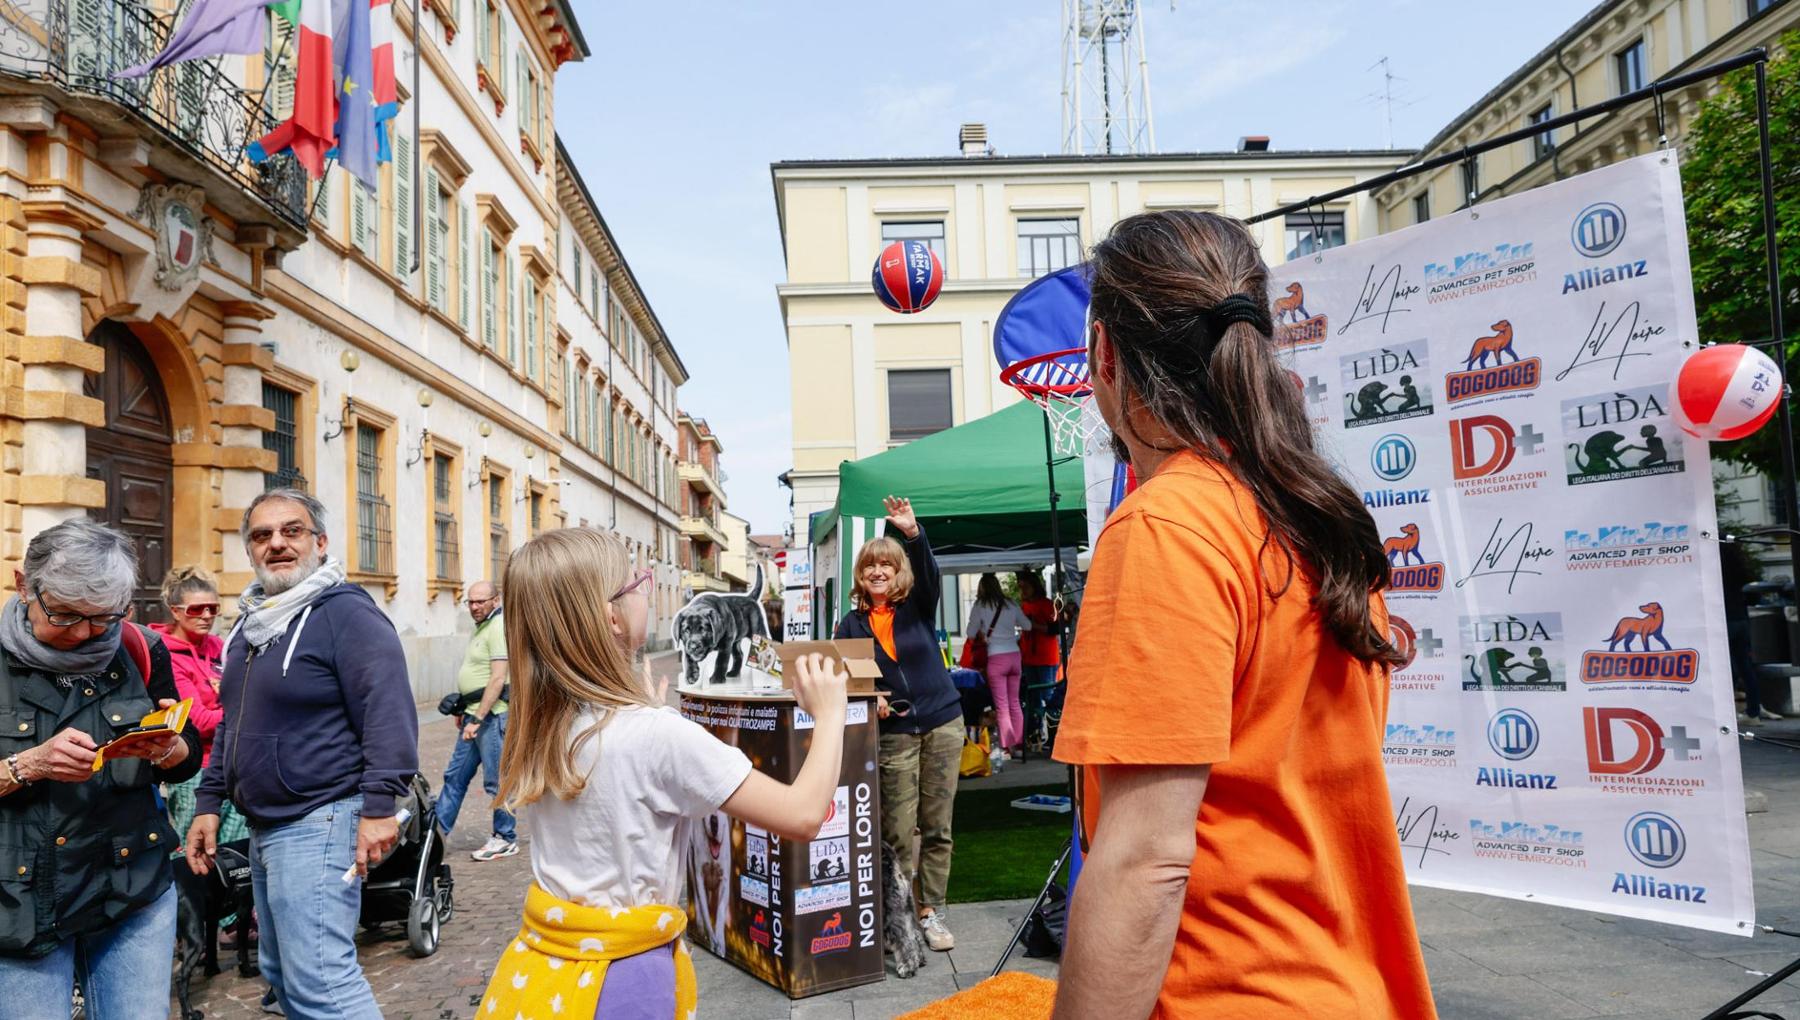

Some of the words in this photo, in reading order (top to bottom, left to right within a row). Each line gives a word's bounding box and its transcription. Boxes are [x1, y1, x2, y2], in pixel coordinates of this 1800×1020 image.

[1430, 276, 1480, 294] ADVANCED
[1484, 270, 1503, 281] PET
[1507, 262, 1535, 275] SHOP
[1562, 259, 1648, 294] Allianz
[1449, 362, 1536, 399] GOGODOG
[1454, 470, 1547, 488] INTERMEDIAZIONI
[1464, 480, 1538, 496] ASSICURATIVE
[1363, 488, 1431, 508] Allianz
[1569, 550, 1626, 561] ADVANCED
[1631, 548, 1653, 557] PET
[1658, 545, 1689, 554] SHOP
[1393, 566, 1439, 587] ODOG
[1587, 654, 1691, 679] GOGODOG
[1411, 748, 1428, 756] PET
[1431, 749, 1455, 757] SHOP
[1476, 766, 1557, 790] Allianz
[1589, 775, 1705, 787] INTERMEDIAZIONI
[1602, 785, 1694, 797] ASSICURATIVE
[855, 782, 872, 848] LORO
[1476, 841, 1529, 852] ADVANCED
[1533, 846, 1552, 854] PET
[1557, 848, 1584, 857] SHOP
[771, 861, 782, 905] PER
[857, 853, 874, 897] PER
[1612, 872, 1707, 904] Allianz
[772, 910, 783, 957] NOI
[859, 902, 875, 948] NOI
